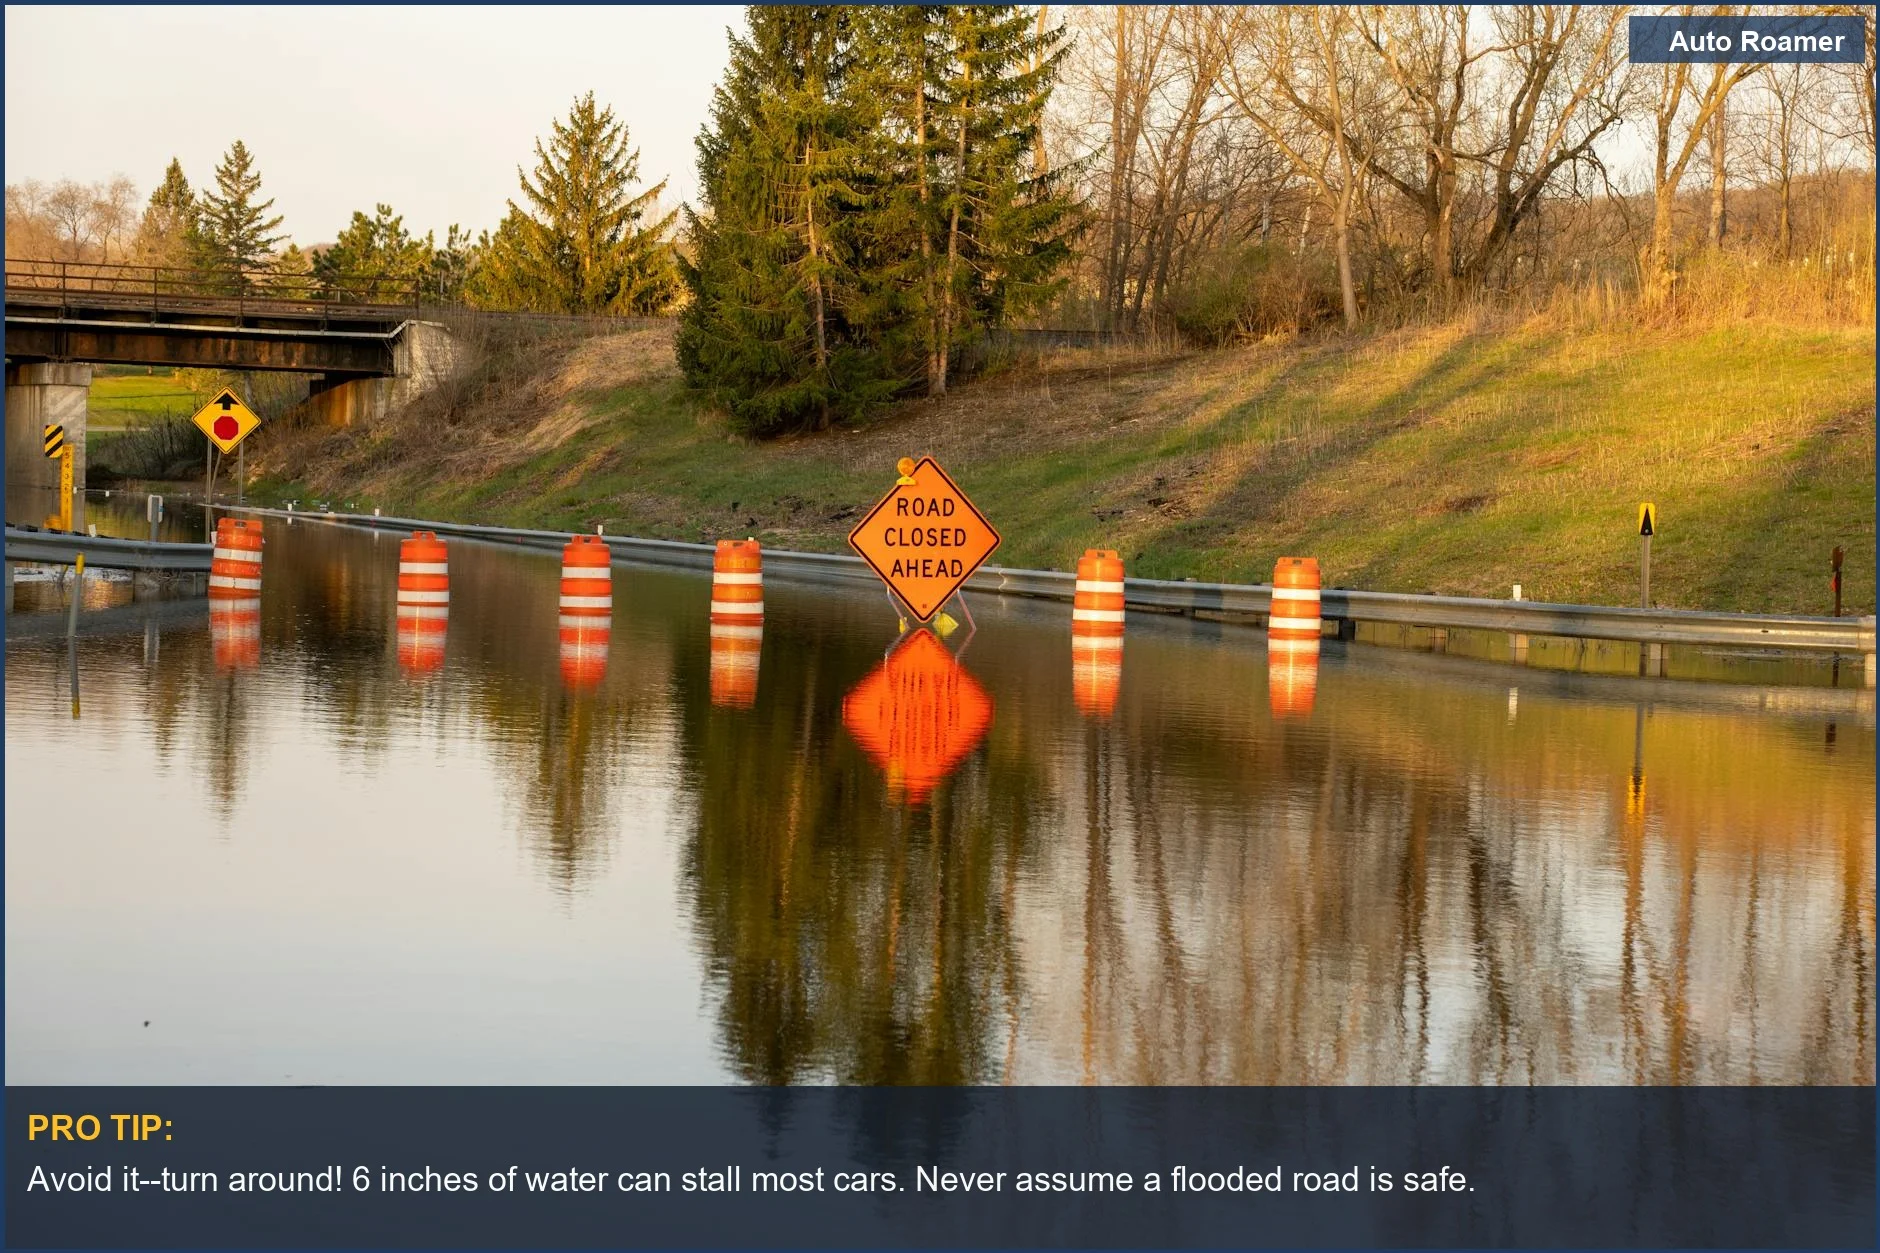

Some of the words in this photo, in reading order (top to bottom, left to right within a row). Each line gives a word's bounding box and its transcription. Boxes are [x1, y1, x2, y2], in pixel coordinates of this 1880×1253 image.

[896, 498, 955, 517] ROAD
[884, 528, 967, 547] CLOSED
[890, 559, 963, 578] AHEAD
